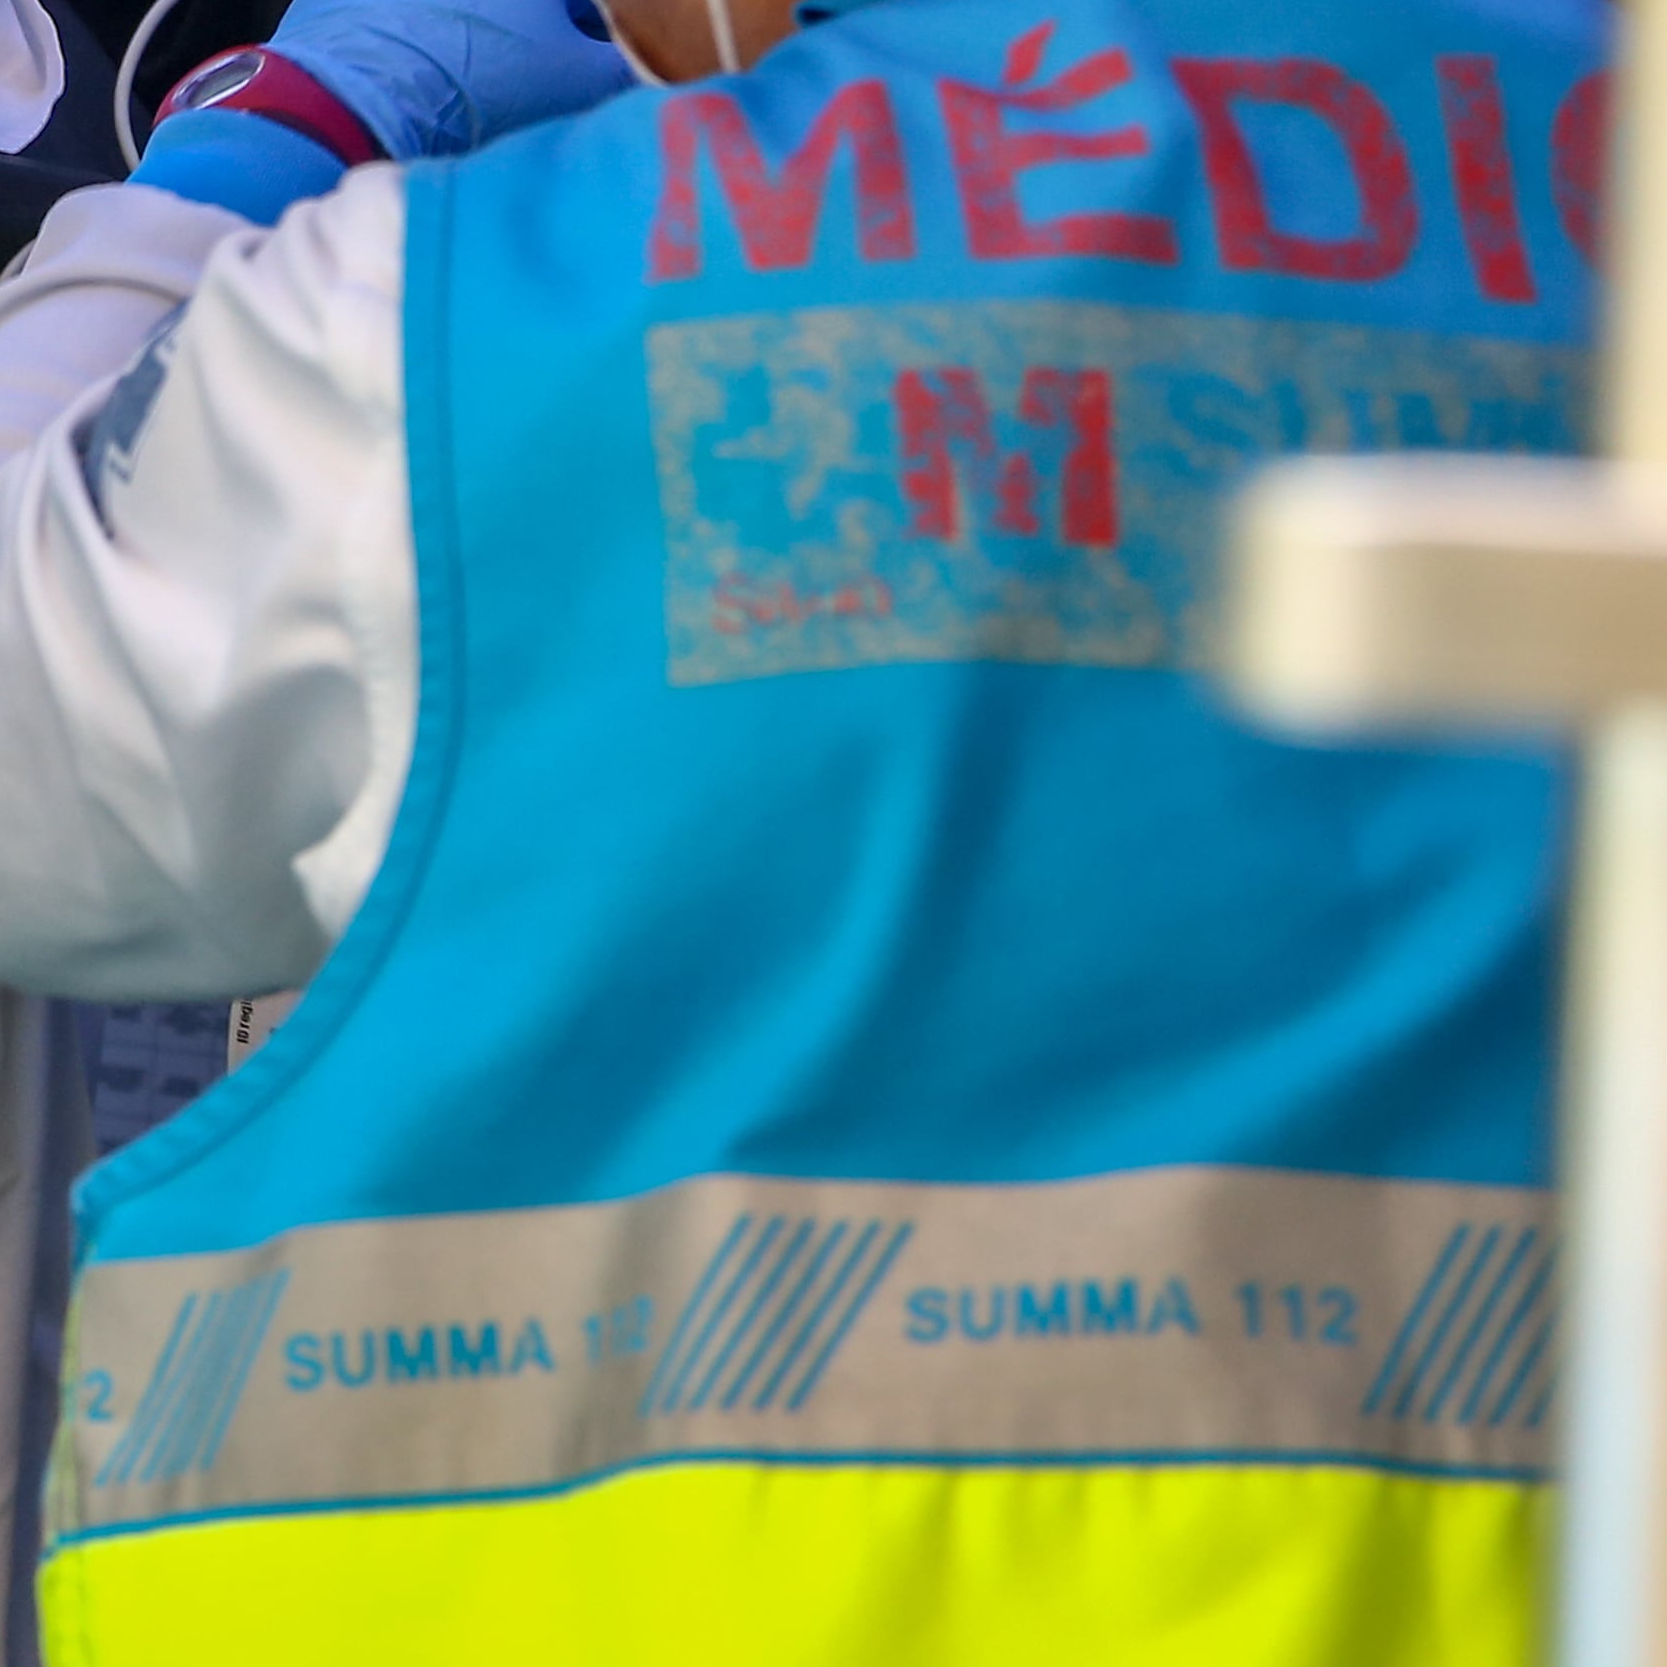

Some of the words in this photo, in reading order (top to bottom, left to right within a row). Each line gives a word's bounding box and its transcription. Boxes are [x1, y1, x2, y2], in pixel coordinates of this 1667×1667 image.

[902, 1276, 1201, 1346] SUMMA
[1231, 1280, 1360, 1346] 112
[282, 1315, 556, 1393] SUMMA
